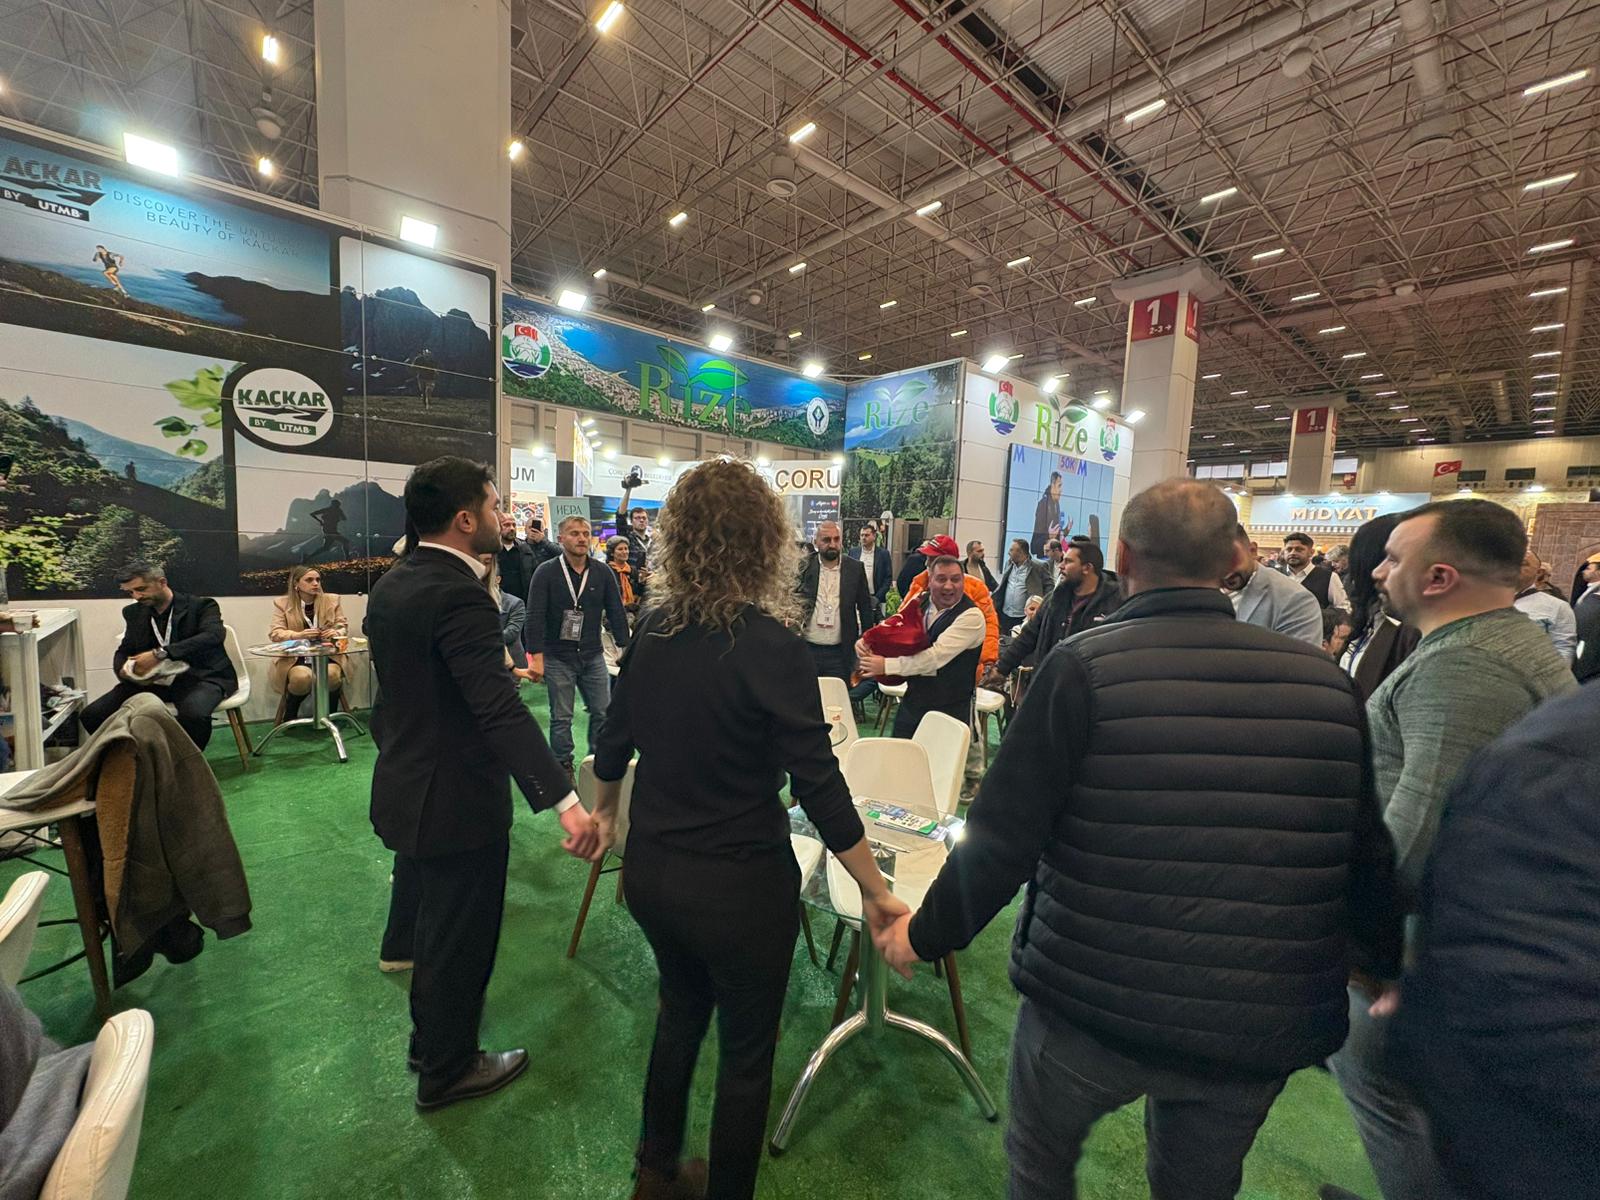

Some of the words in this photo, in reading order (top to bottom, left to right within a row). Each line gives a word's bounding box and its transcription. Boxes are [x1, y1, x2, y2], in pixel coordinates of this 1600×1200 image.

[4, 189, 21, 200] BY
[38, 200, 81, 217] UTMB
[113, 190, 198, 221] DISCOVER
[202, 214, 232, 231] THE
[146, 211, 212, 236] BEAUTY
[218, 230, 237, 241] OF
[1147, 299, 1160, 326] 1
[1192, 301, 1199, 328] 1
[635, 359, 752, 428] Rize
[279, 423, 309, 433] UTMB
[863, 400, 929, 431] Rize
[1033, 402, 1088, 454] Rize
[1307, 410, 1317, 426] 1
[775, 470, 840, 493] ÇORU
